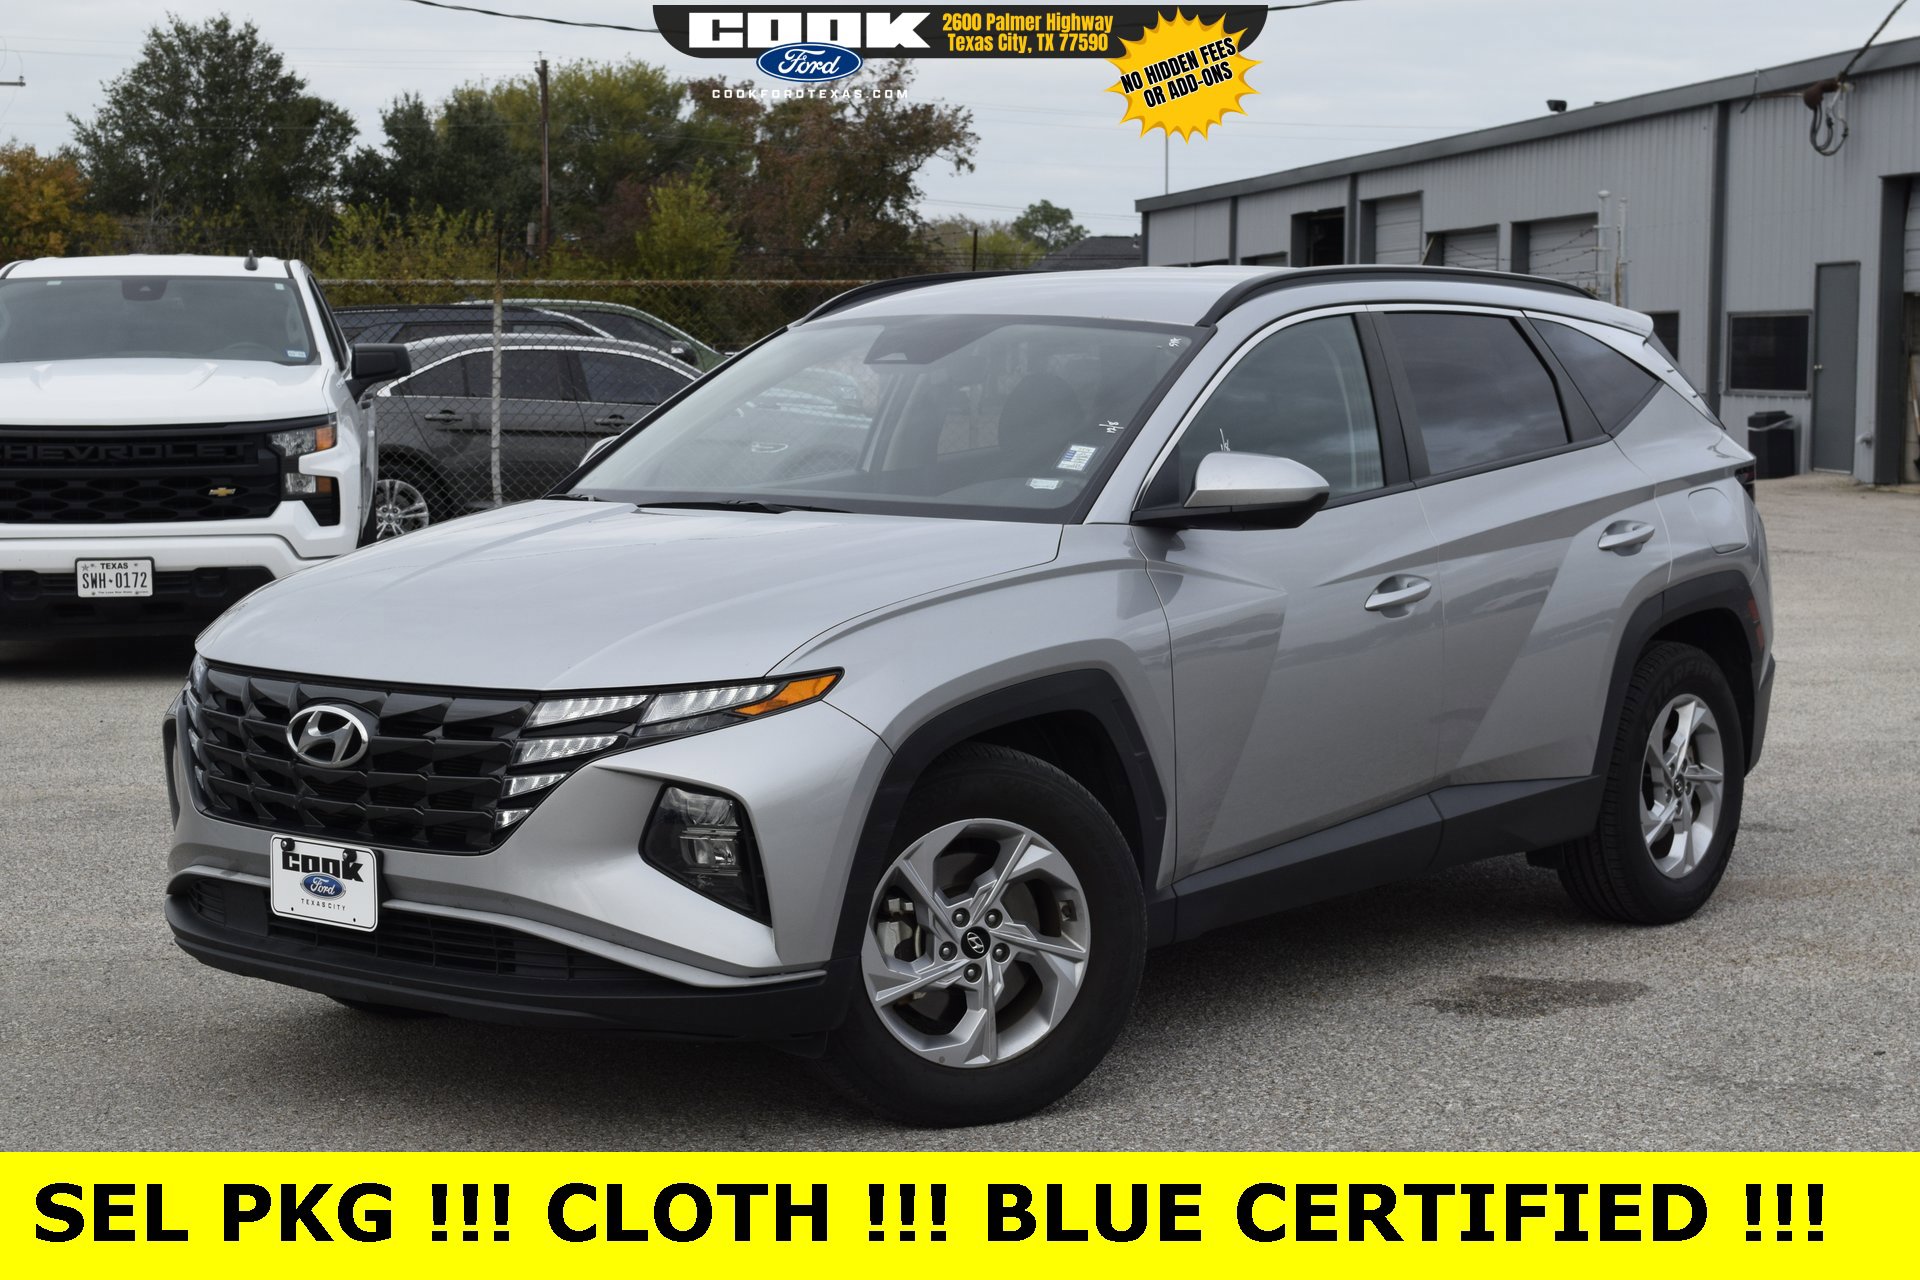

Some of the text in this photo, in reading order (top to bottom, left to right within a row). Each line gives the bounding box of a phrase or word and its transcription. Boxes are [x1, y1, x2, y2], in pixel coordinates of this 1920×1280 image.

[0, 441, 253, 463] HEVROLET
[100, 562, 128, 570] TEXAS
[282, 851, 364, 882] COOK
[310, 877, 335, 895] Ford
